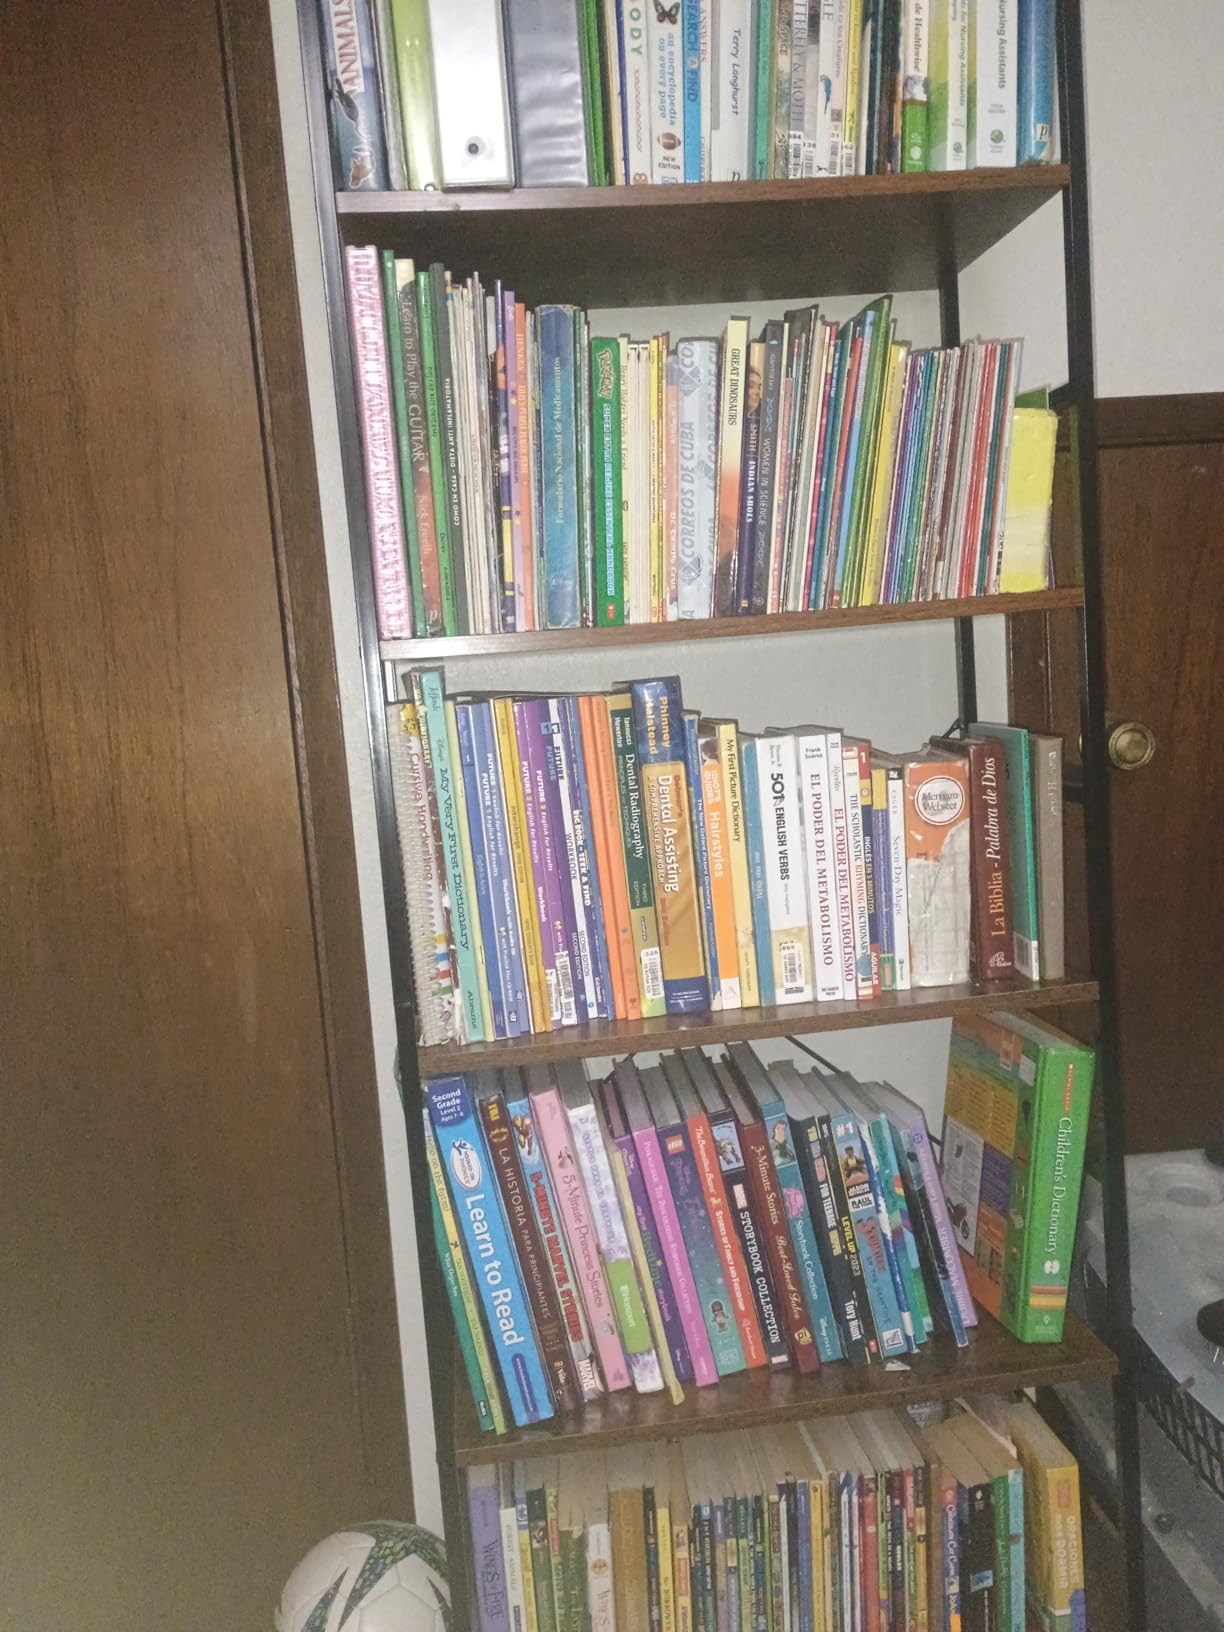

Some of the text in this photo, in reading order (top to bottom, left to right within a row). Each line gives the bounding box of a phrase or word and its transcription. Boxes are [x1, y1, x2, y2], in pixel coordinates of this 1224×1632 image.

[914, 3, 925, 71] de Healthwise
[998, 38, 1007, 89] Assistants
[659, 56, 668, 86] every
[668, 51, 679, 126] encyclopedia
[687, 70, 699, 102] FIND
[731, 29, 742, 116] Terry Longhurst
[659, 91, 668, 119] page
[401, 302, 427, 462] Learn to Play the GUITAR
[728, 348, 741, 426] GREAT DINOSAURS
[602, 403, 611, 431] SUPER
[554, 434, 564, 472] Nacional
[603, 433, 612, 462] EXTRA
[747, 423, 758, 492] SMITH INDIAN
[605, 463, 613, 498] DELUXE
[680, 422, 696, 558] CORREOS DE CUBA
[758, 438, 772, 526] WOMEN IN SCIENCE
[606, 548, 615, 596] HANDBOOK
[645, 698, 659, 754] Halstead
[659, 696, 671, 748] Phinney
[410, 753, 424, 801] Cursive
[482, 773, 491, 806] FUTURE
[487, 753, 496, 786] FUTURE
[536, 770, 545, 802] FUTURE
[725, 739, 741, 842] My First Picture Dictionary
[625, 754, 645, 859] Dental Radiography
[658, 775, 681, 893] Dental Assisting
[522, 761, 547, 922] FUTURE Workbook
[554, 746, 564, 780] FUTURE
[582, 954, 590, 976] EDITION
[655, 845, 664, 883] APPROACH
[709, 811, 725, 878] Hairstyles
[775, 807, 790, 880] ENGLISH VERBS
[851, 812, 864, 862] SCHOLASTIC
[981, 757, 1006, 936] La Biblia Palabra de Dios
[440, 768, 477, 1029] My Very First Dictionary Abrams
[704, 876, 712, 909] Dictionary
[810, 774, 834, 966] EL PODER DEL METABOLISMO
[834, 808, 854, 982] EL PODER DEL METABOLISMO
[855, 864, 866, 904] RHYMING
[866, 880, 874, 914] MINUTOS
[572, 932, 580, 955] SECOND
[858, 906, 868, 955] DICTIONARY
[432, 1089, 462, 1103] Second
[435, 1098, 461, 1108] Grade
[433, 1171, 443, 1185] the
[459, 1158, 470, 1185] PHONICS
[464, 1150, 475, 1180] HOOKED ON
[1045, 1116, 1073, 1254] Children's Dictionary
[465, 1193, 494, 1257] Learn
[562, 1174, 604, 1308] 5-Minute Princess Stories
[842, 1216, 861, 1276] LEVEL UP 2023
[483, 1260, 503, 1285] to
[498, 1148, 566, 1384] LA HISTORIA PARA PRINCIPIANTES Vida
[732, 1184, 780, 1344] MARVEL STORYBOOK COLLECTION
[765, 1192, 778, 1225] Stories
[789, 1293, 802, 1320] Tales
[796, 1219, 819, 1300] Storybook Collection
[819, 1183, 862, 1341] FOR TEENAGE Tory Hunt
[490, 1287, 525, 1346] Read
[547, 1236, 570, 1289] MARVEL
[560, 1288, 584, 1343] STORIES
[577, 1359, 596, 1392] MARVEL
[1056, 1539, 1068, 1589] DORMIR
[1068, 1515, 1079, 1585] ORACIONES
